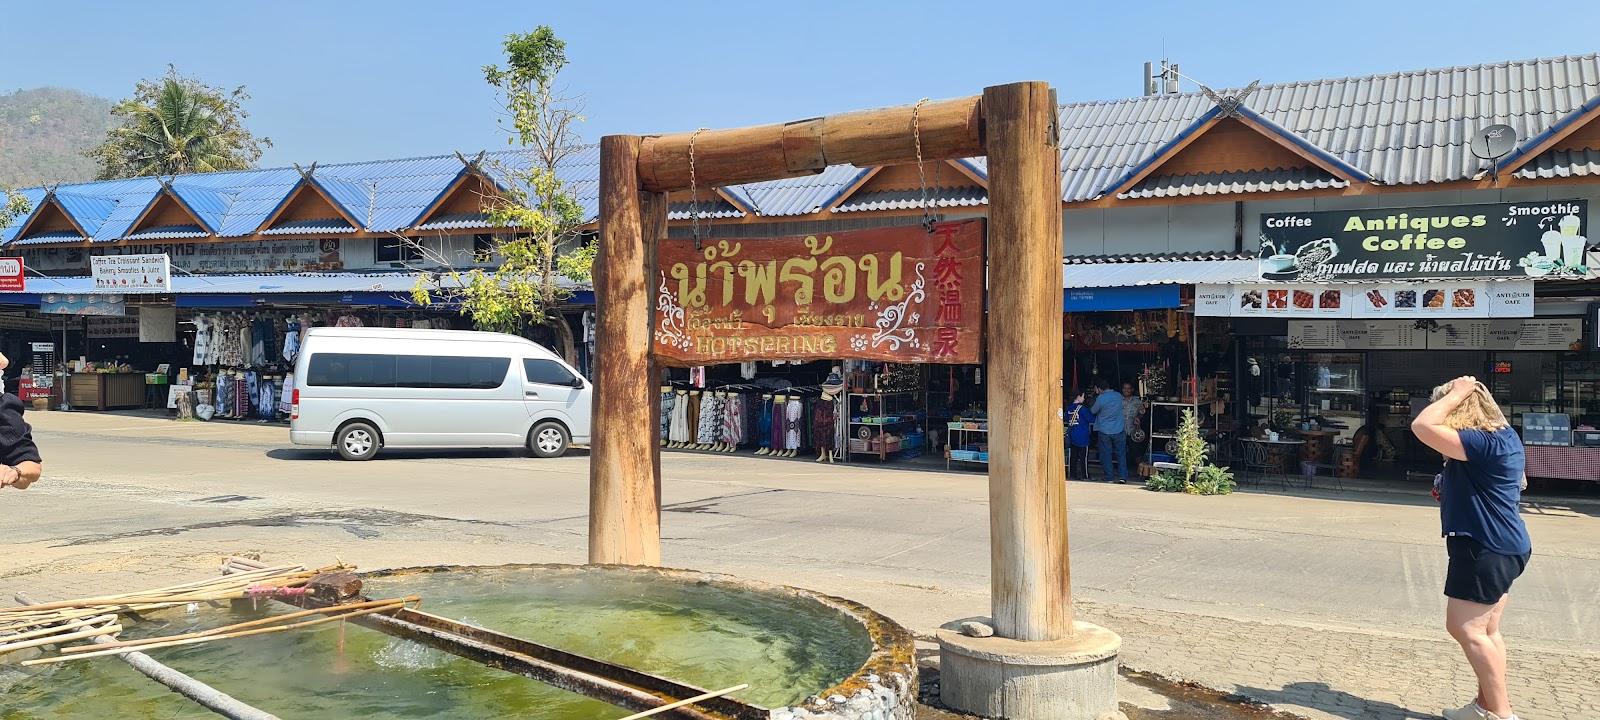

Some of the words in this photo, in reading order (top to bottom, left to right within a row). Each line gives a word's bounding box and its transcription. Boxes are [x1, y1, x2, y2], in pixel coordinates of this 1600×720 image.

[1508, 204, 1580, 217] Smoothie
[1266, 216, 1313, 228] Coffee
[1343, 212, 1487, 235] Antiques
[1361, 233, 1467, 253] Coffee
[1316, 257, 1381, 275] กาแฟสด
[1383, 259, 1415, 274] และ
[670, 235, 904, 324] น้ำพุร้อน
[696, 334, 838, 355] HOTSPRING
